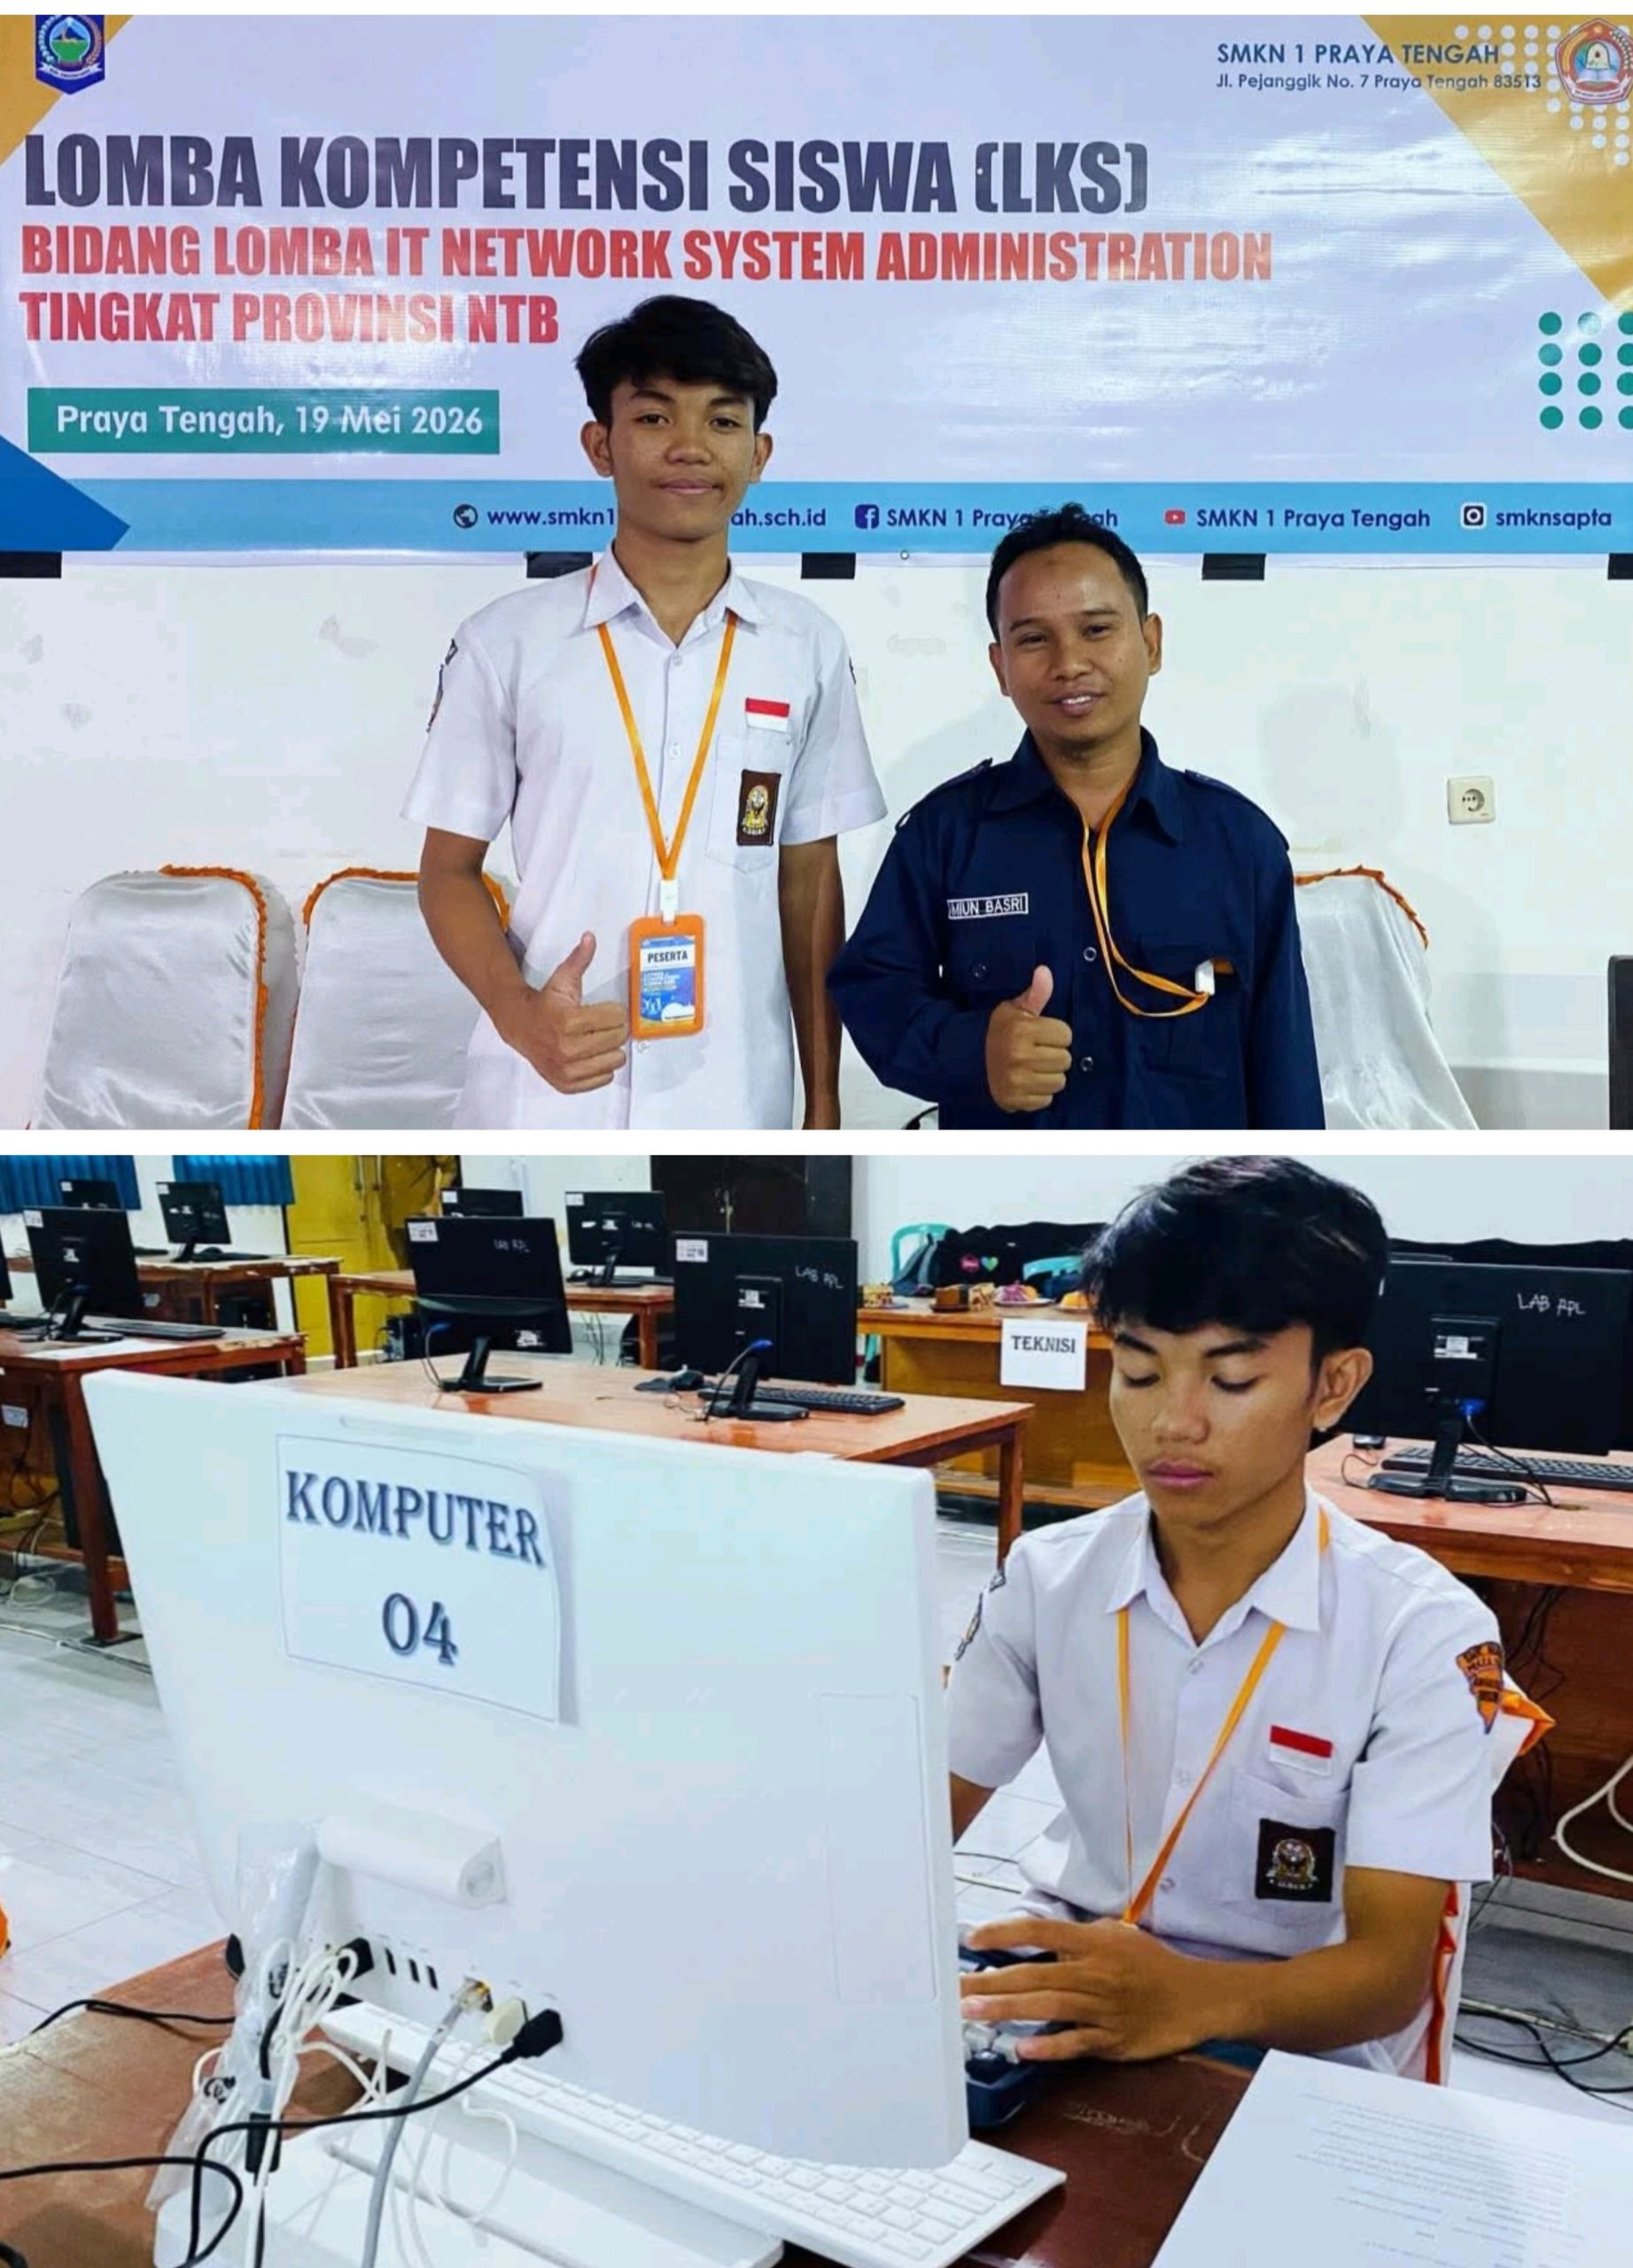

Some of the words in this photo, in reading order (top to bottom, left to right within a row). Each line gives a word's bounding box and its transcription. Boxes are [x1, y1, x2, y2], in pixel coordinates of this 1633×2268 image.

[1217, 43, 1285, 64] SMKN
[1295, 43, 1304, 64] 1
[1315, 43, 1394, 64] PRAYA
[1402, 44, 1499, 64] TENGAH
[1216, 74, 1233, 88] Jl.
[1239, 74, 1320, 91] Pejanggik
[1327, 74, 1354, 88] No.
[1360, 74, 1369, 88] 7
[1375, 74, 1421, 91] Praya
[1427, 74, 1488, 92] Tengah
[1493, 74, 1541, 89] 83513
[24, 133, 262, 207] LOMBA
[281, 136, 708, 211] KOMPETENSI
[728, 139, 957, 214] SISWA
[976, 141, 1147, 214] (LKS)
[22, 225, 199, 275] BIDANG
[214, 226, 373, 276] LOMBA
[386, 228, 430, 276] IT
[443, 229, 672, 278] NETWORK
[683, 230, 864, 280] SYSTEM
[876, 231, 1271, 282] ADMINISTRATION
[19, 292, 220, 342] TINGKAT
[233, 293, 454, 343] PROVINSI
[469, 295, 559, 344] NTB
[58, 406, 147, 439] Praya
[159, 406, 284, 439] Tengah,
[295, 406, 329, 433] 19
[340, 405, 401, 434] Mei
[411, 406, 483, 435] 2026
[887, 509, 947, 527] SMKN
[955, 509, 963, 527] 1
[1196, 509, 1257, 527] SMKN
[1266, 509, 1274, 527] 1
[1284, 509, 1344, 531] Praya
[1351, 509, 1430, 531] Tengah
[1496, 508, 1612, 531] smknsapta
[985, 897, 1023, 913] BASRI
[647, 950, 688, 963] PESERTA
[1517, 1293, 1551, 1313] LAB
[1010, 1334, 1077, 1355] TEKNISI
[285, 1470, 546, 1568] KOMPUTER
[382, 1592, 458, 1666] 04
